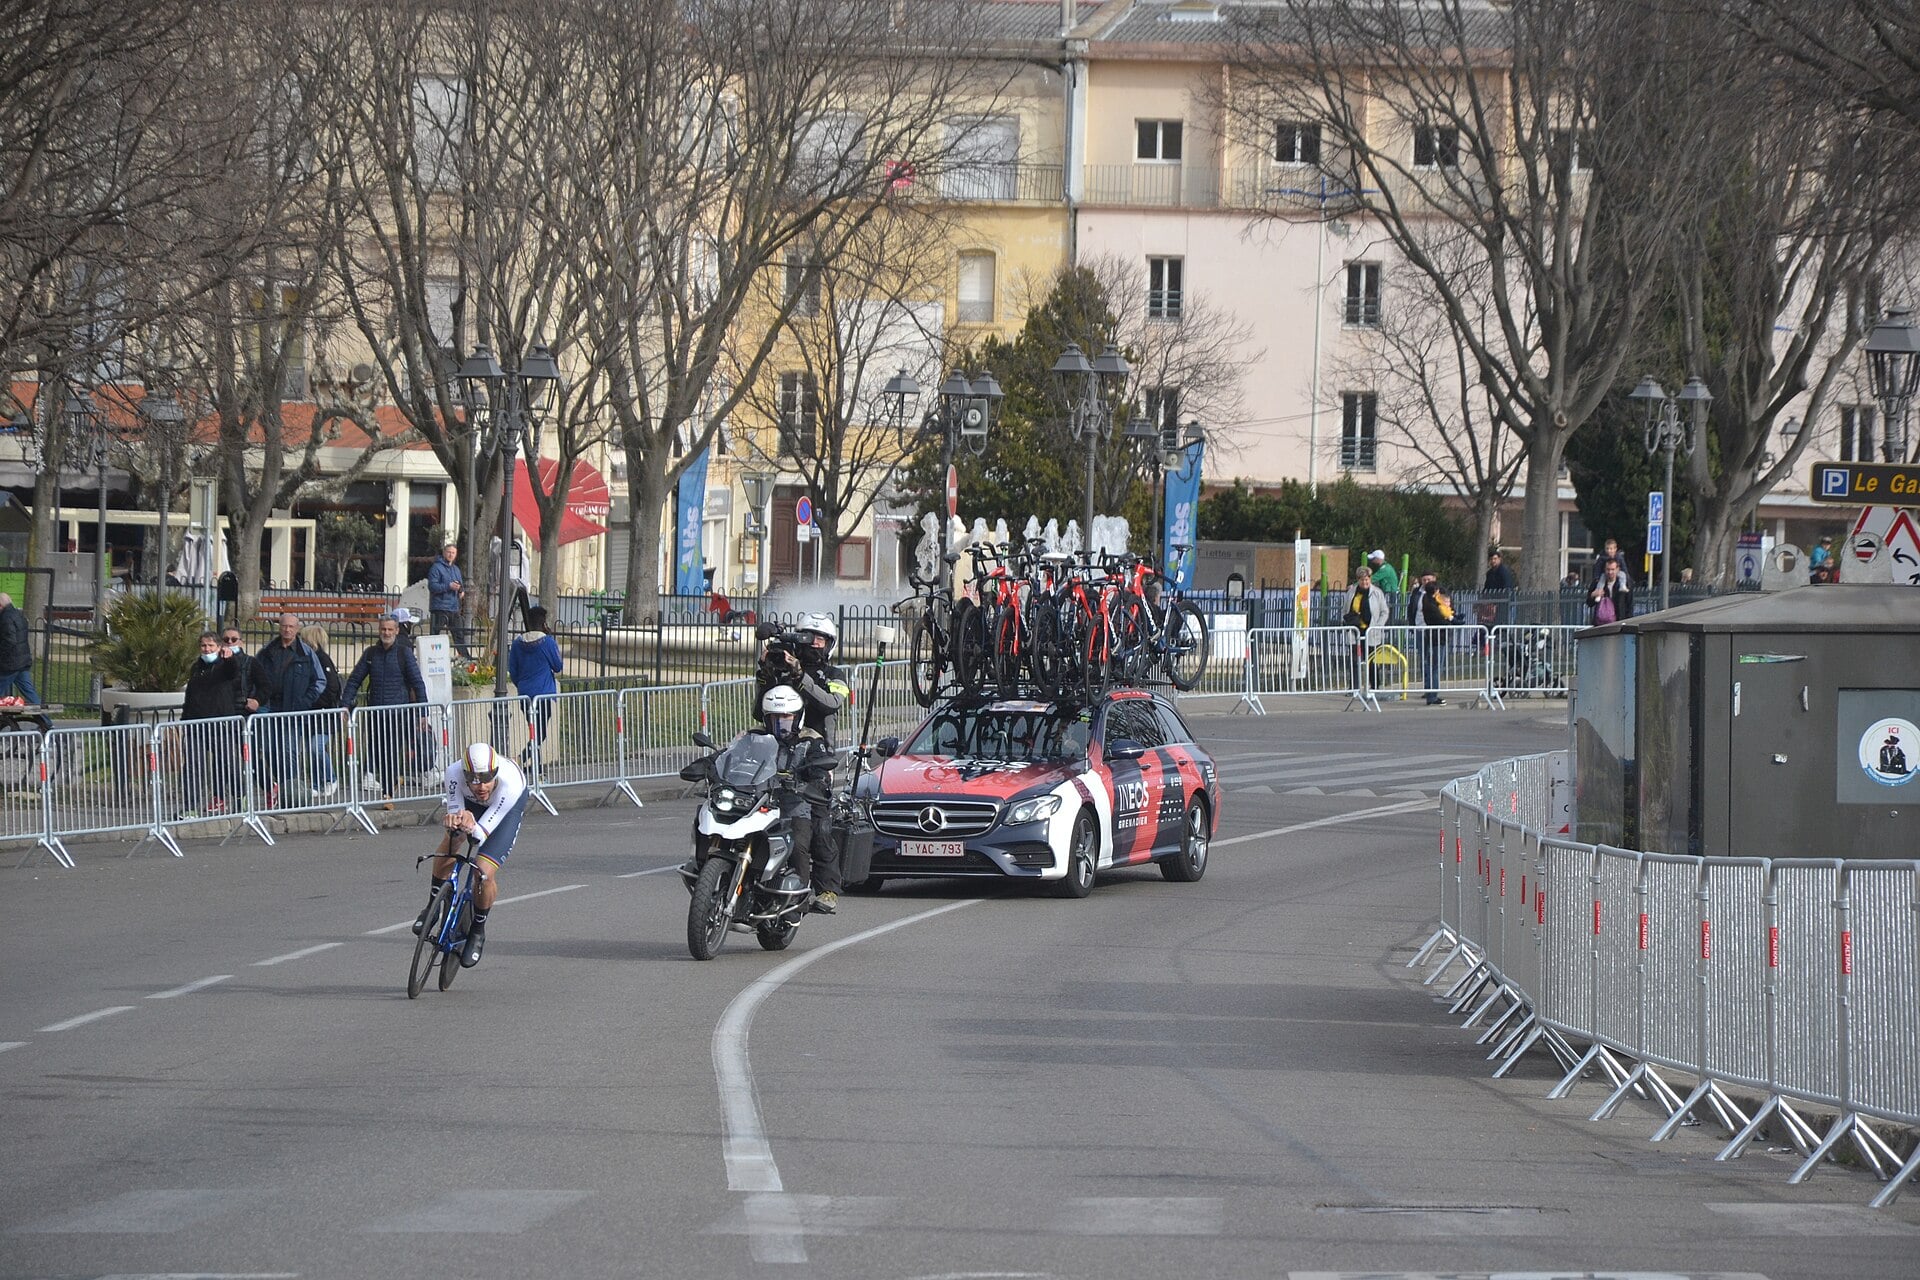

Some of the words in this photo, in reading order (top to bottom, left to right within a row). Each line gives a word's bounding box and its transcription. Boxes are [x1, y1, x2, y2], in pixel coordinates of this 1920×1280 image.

[1854, 473, 1878, 492] Le
[1890, 474, 1920, 494] Ga
[449, 780, 457, 802] INEOS
[1118, 781, 1149, 811] INEOS
